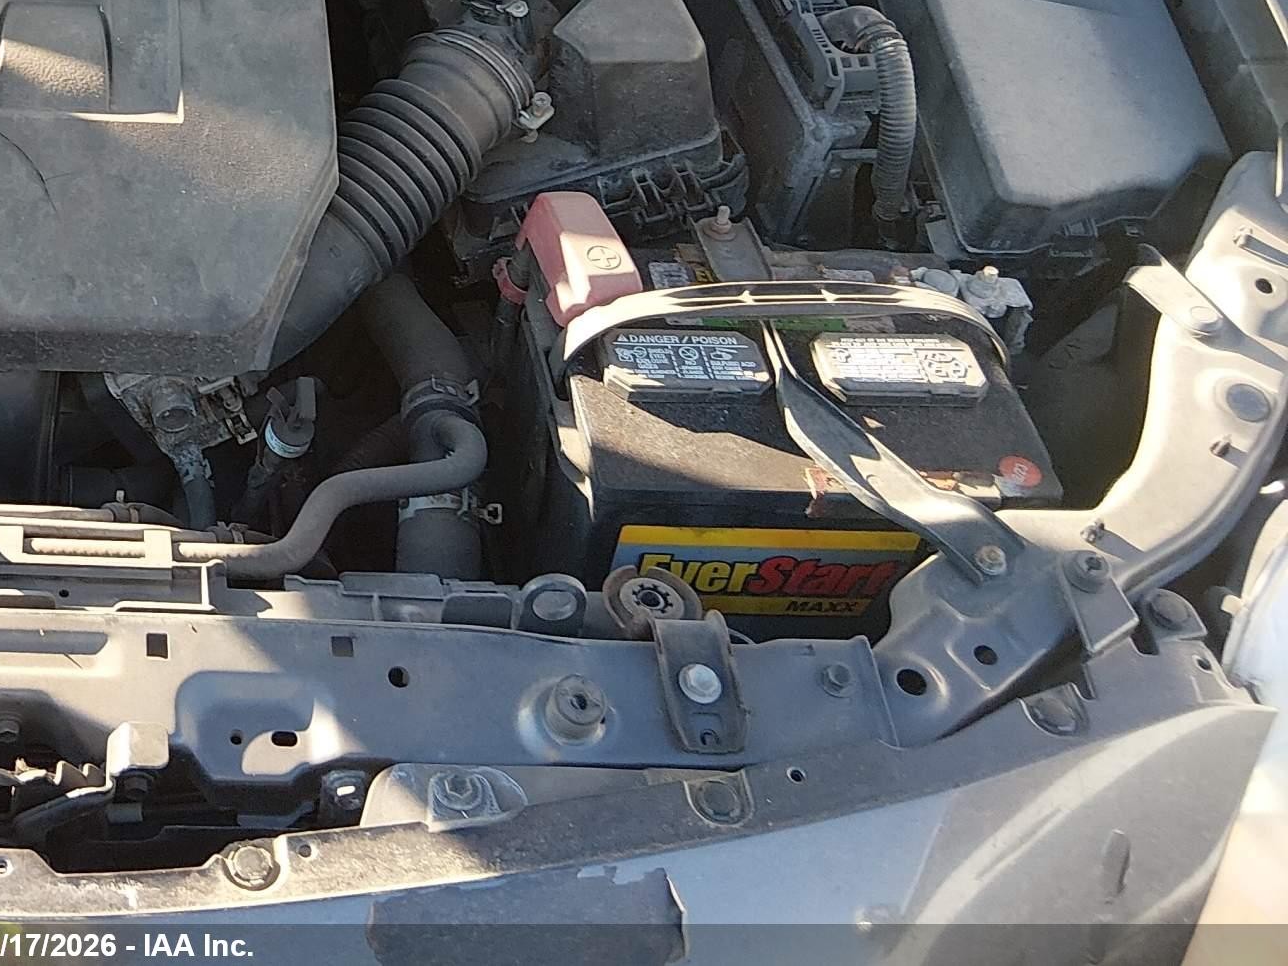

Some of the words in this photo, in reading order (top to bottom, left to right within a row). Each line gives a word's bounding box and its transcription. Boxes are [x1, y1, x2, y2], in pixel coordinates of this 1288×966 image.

[629, 334, 680, 344] DANGER
[691, 335, 737, 345] POISON
[785, 601, 858, 613] MAXX
